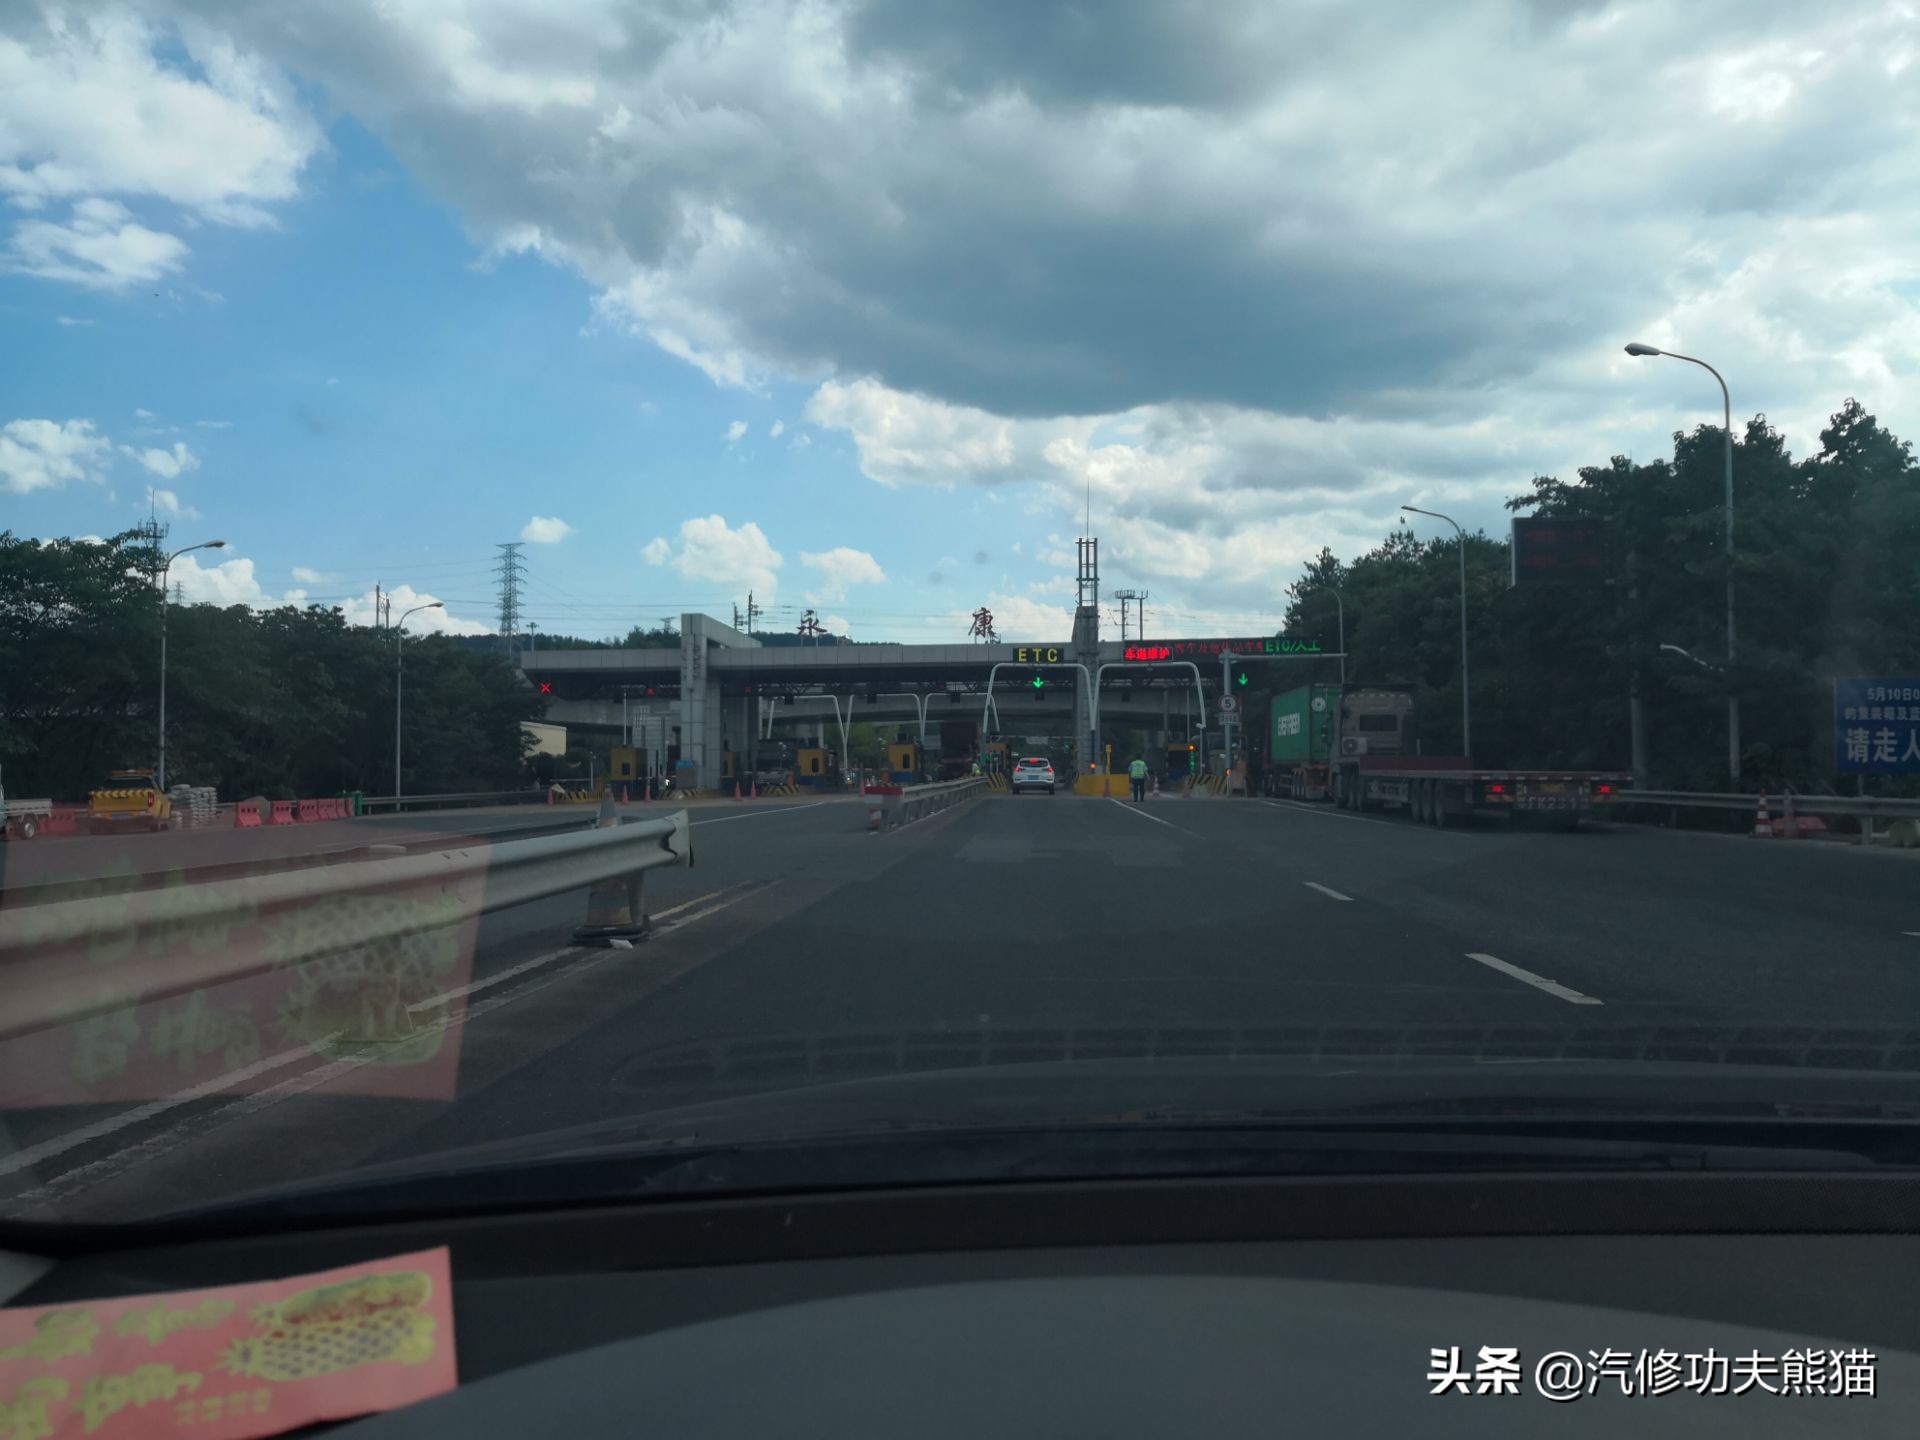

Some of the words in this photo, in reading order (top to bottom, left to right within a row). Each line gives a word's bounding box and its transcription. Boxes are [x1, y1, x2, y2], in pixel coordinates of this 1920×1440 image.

[1265, 640, 1321, 653] ETC/人工
[1018, 648, 1058, 662] ETC
[1845, 727, 1920, 763] 请走人
